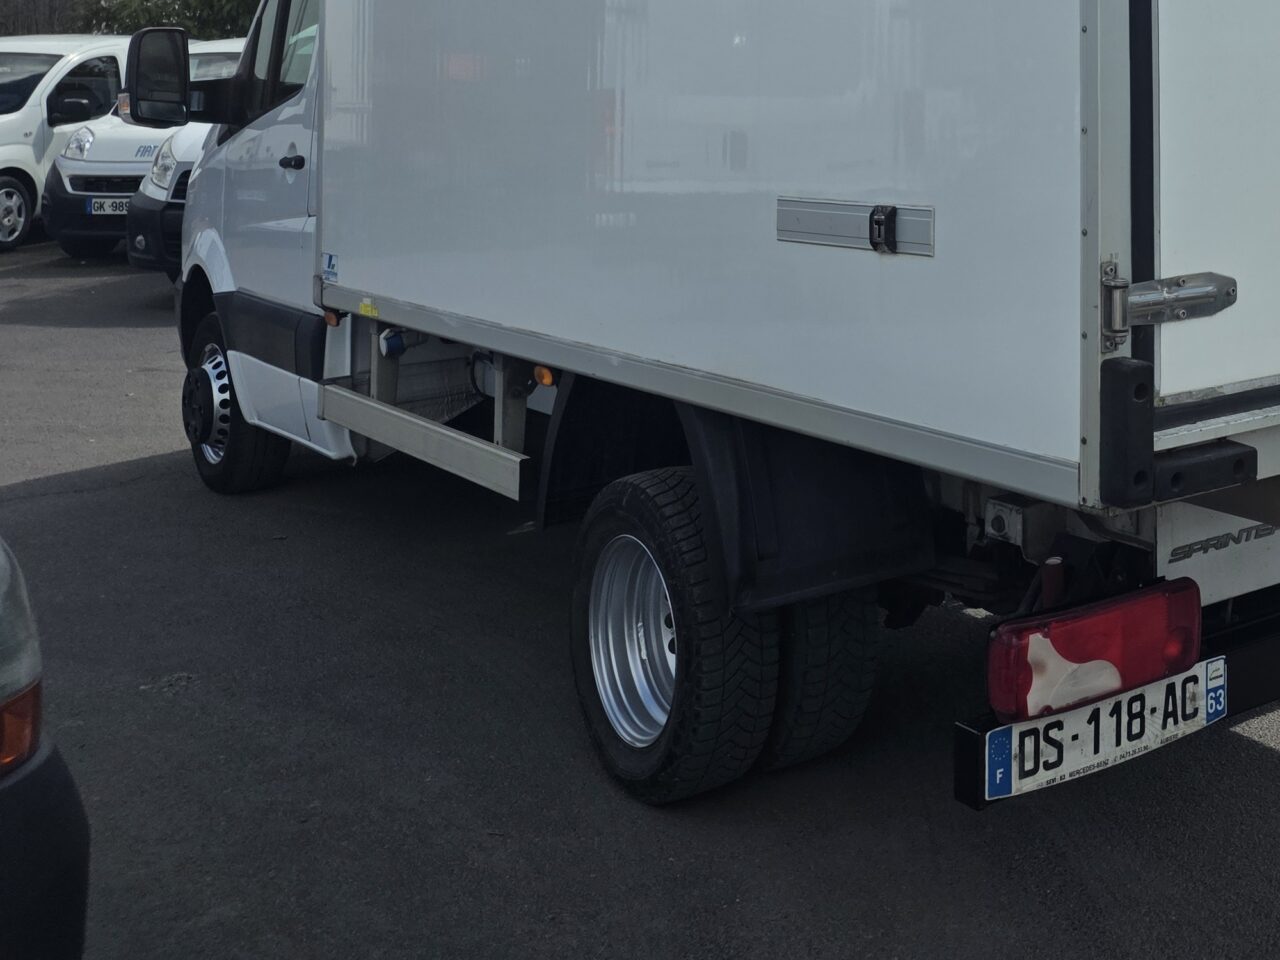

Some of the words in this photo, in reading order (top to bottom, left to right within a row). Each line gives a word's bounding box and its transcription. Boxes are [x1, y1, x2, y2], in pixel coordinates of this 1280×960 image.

[135, 145, 159, 158] FIAT
[996, 768, 1004, 784] F
[1018, 674, 1199, 780] DS-118-AC
[1207, 689, 1225, 714] 63
